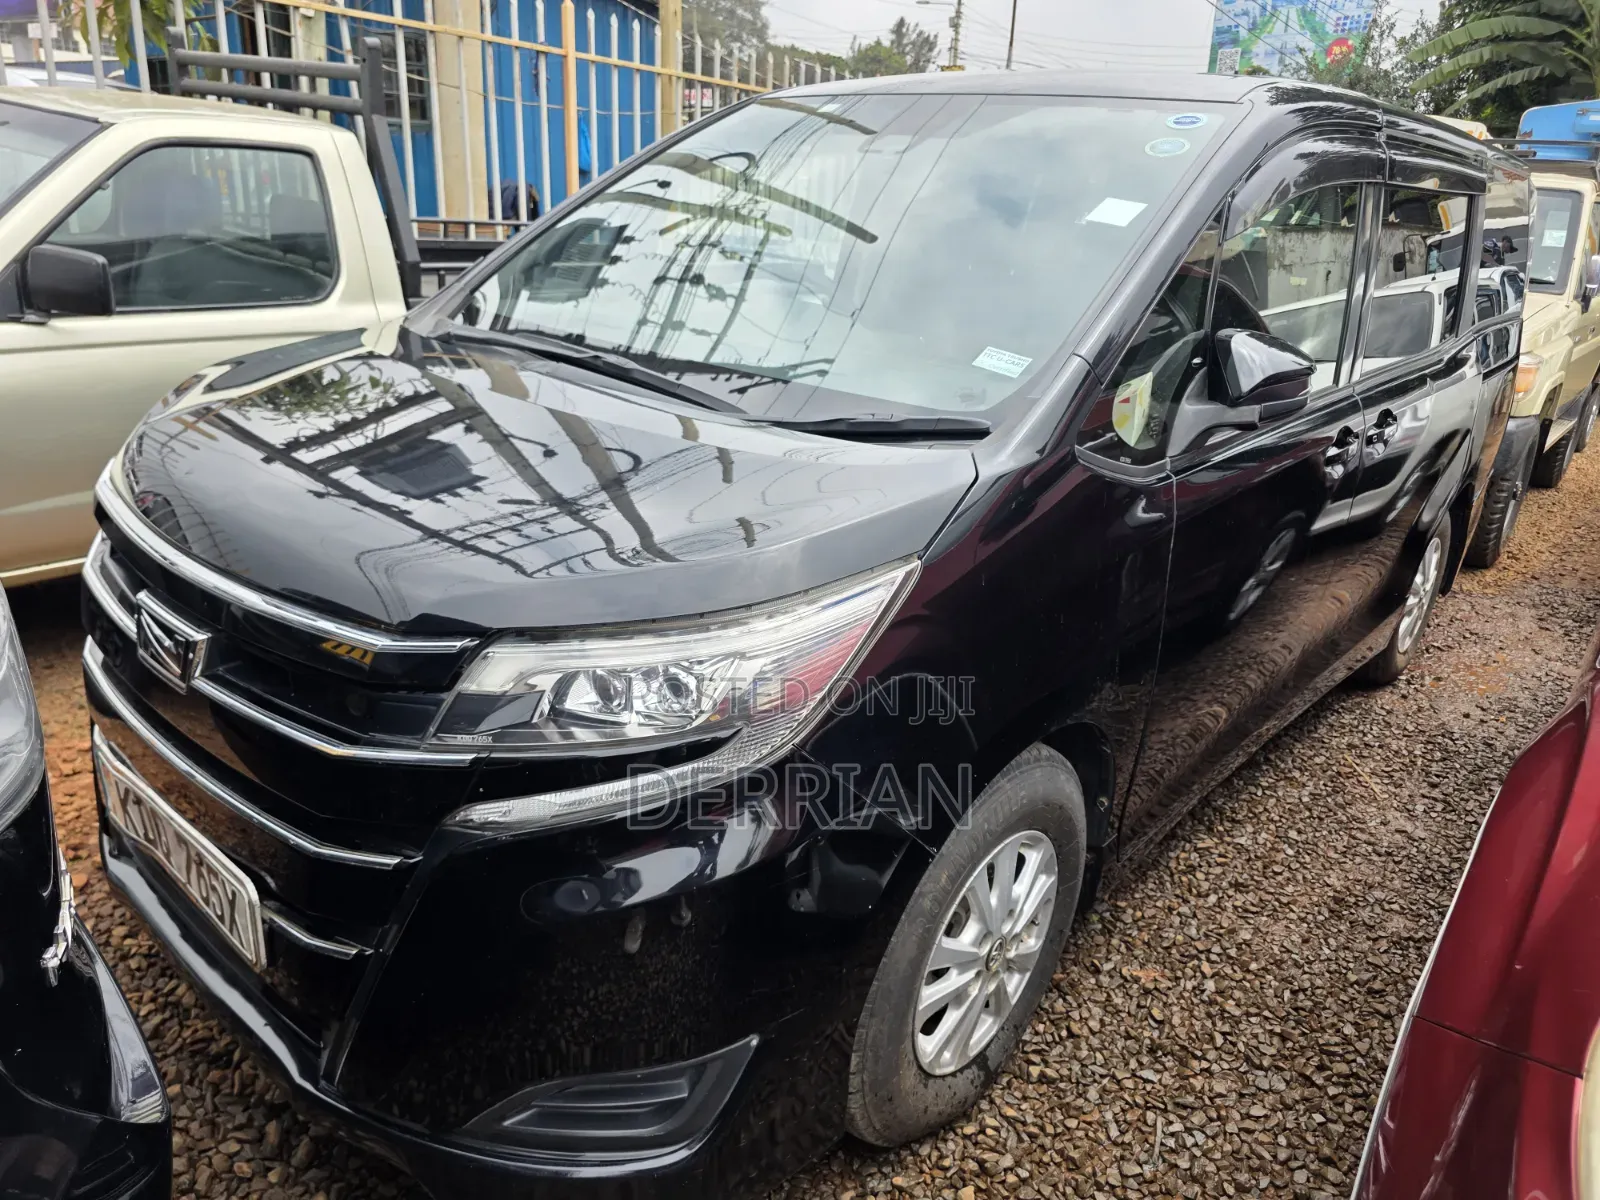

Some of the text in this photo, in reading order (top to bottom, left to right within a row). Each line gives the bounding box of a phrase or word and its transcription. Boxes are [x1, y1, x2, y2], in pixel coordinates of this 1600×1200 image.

[983, 351, 1026, 368] TTC U-CARS
[178, 835, 248, 951] 765X
